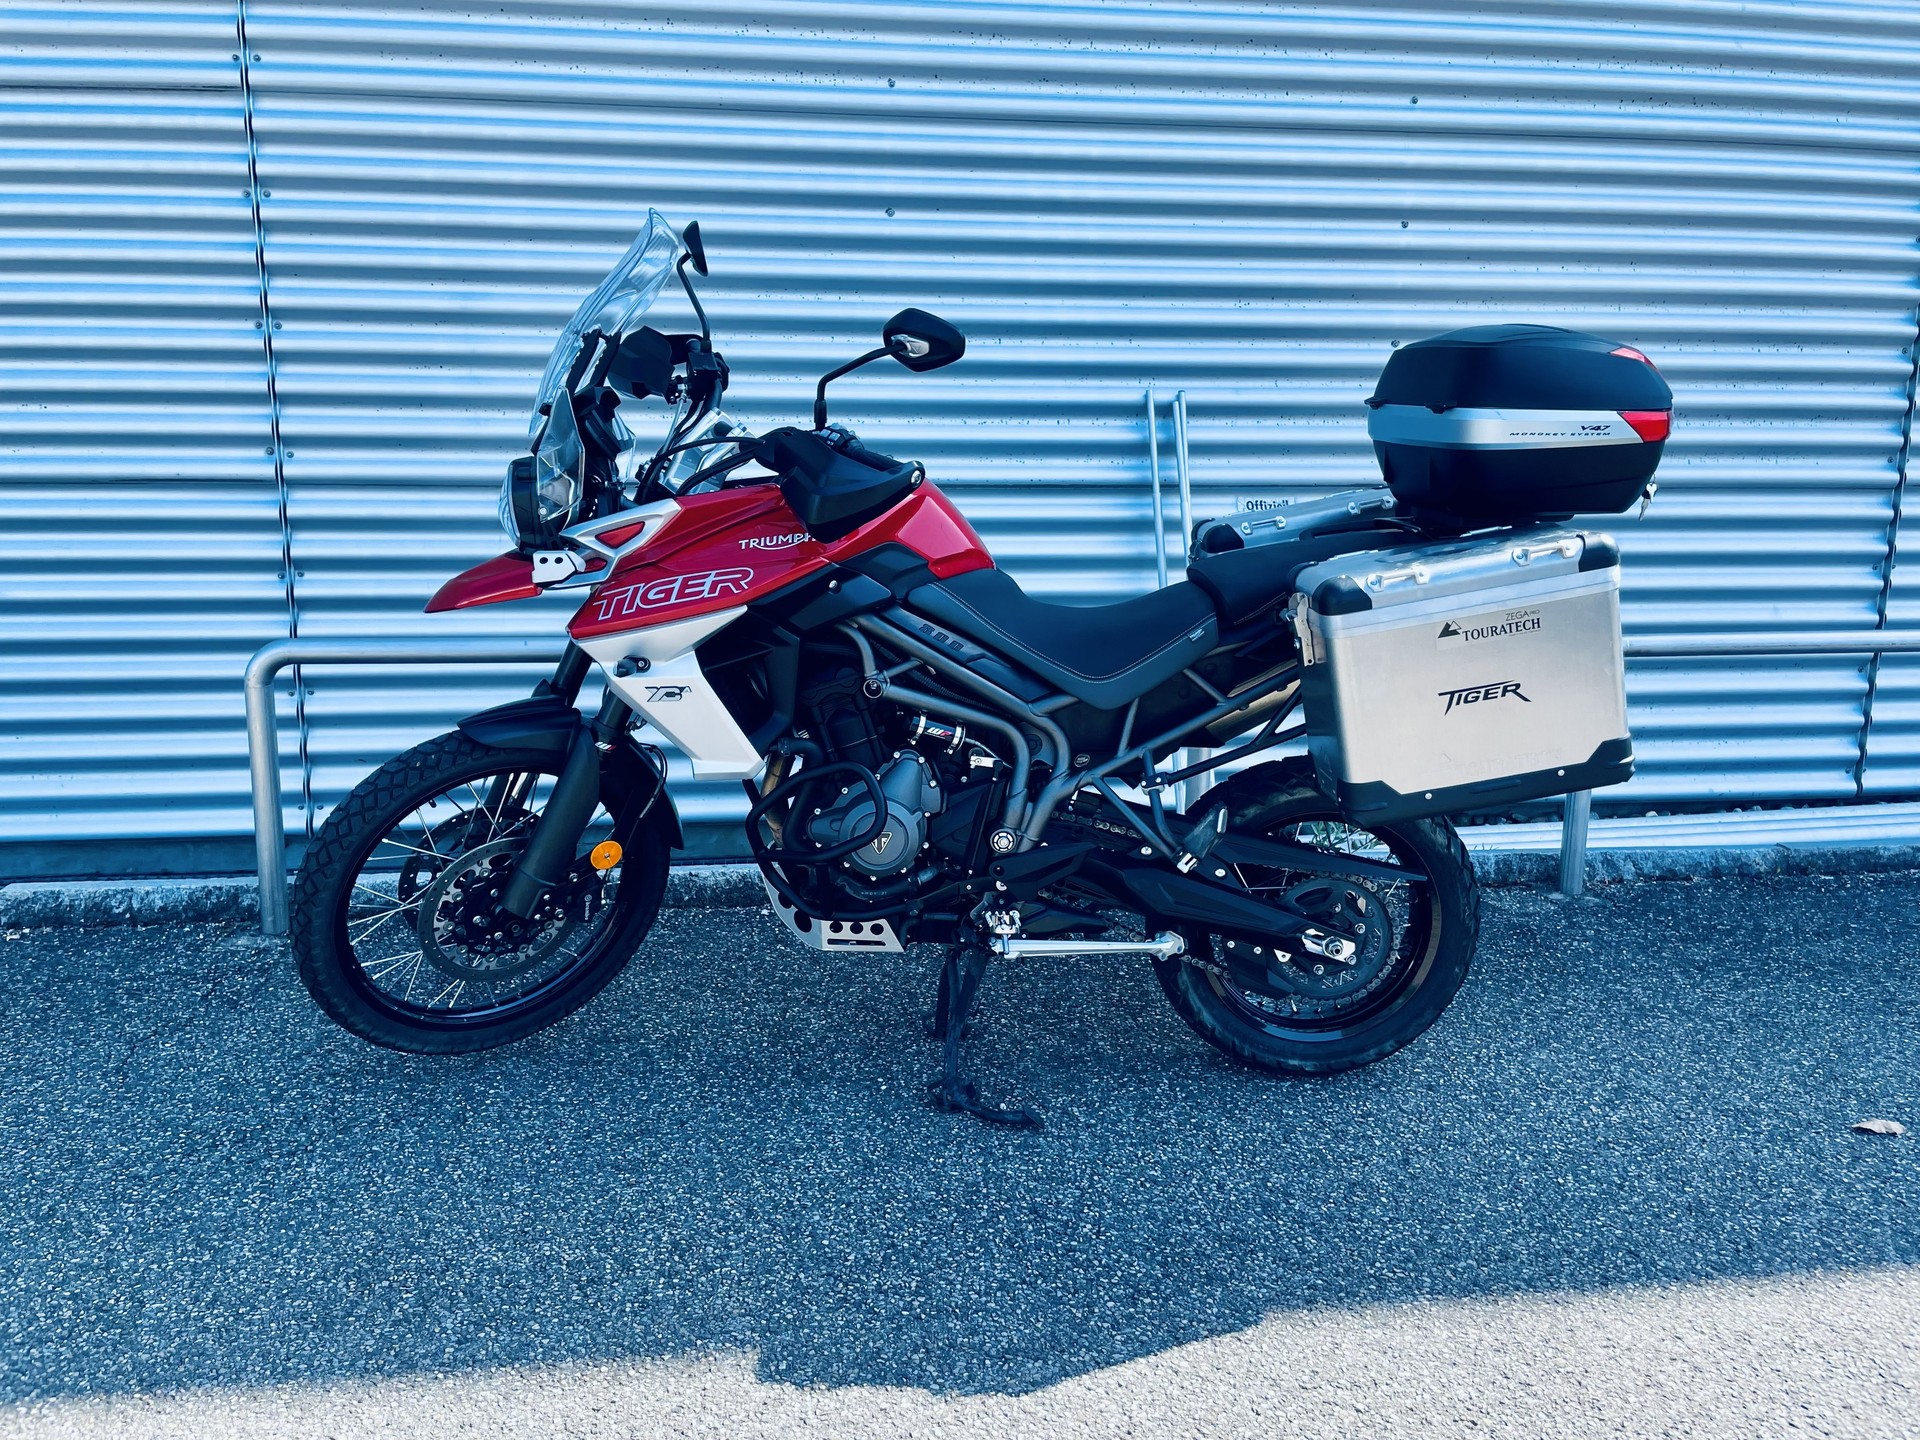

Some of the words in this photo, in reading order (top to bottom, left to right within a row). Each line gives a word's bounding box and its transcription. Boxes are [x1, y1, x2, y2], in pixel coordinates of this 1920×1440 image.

[592, 567, 754, 621] TIGER
[1462, 617, 1541, 641] TOURATECH
[1505, 610, 1530, 621] ZEGA
[918, 623, 964, 652] 800
[1437, 680, 1532, 716] TIGER
